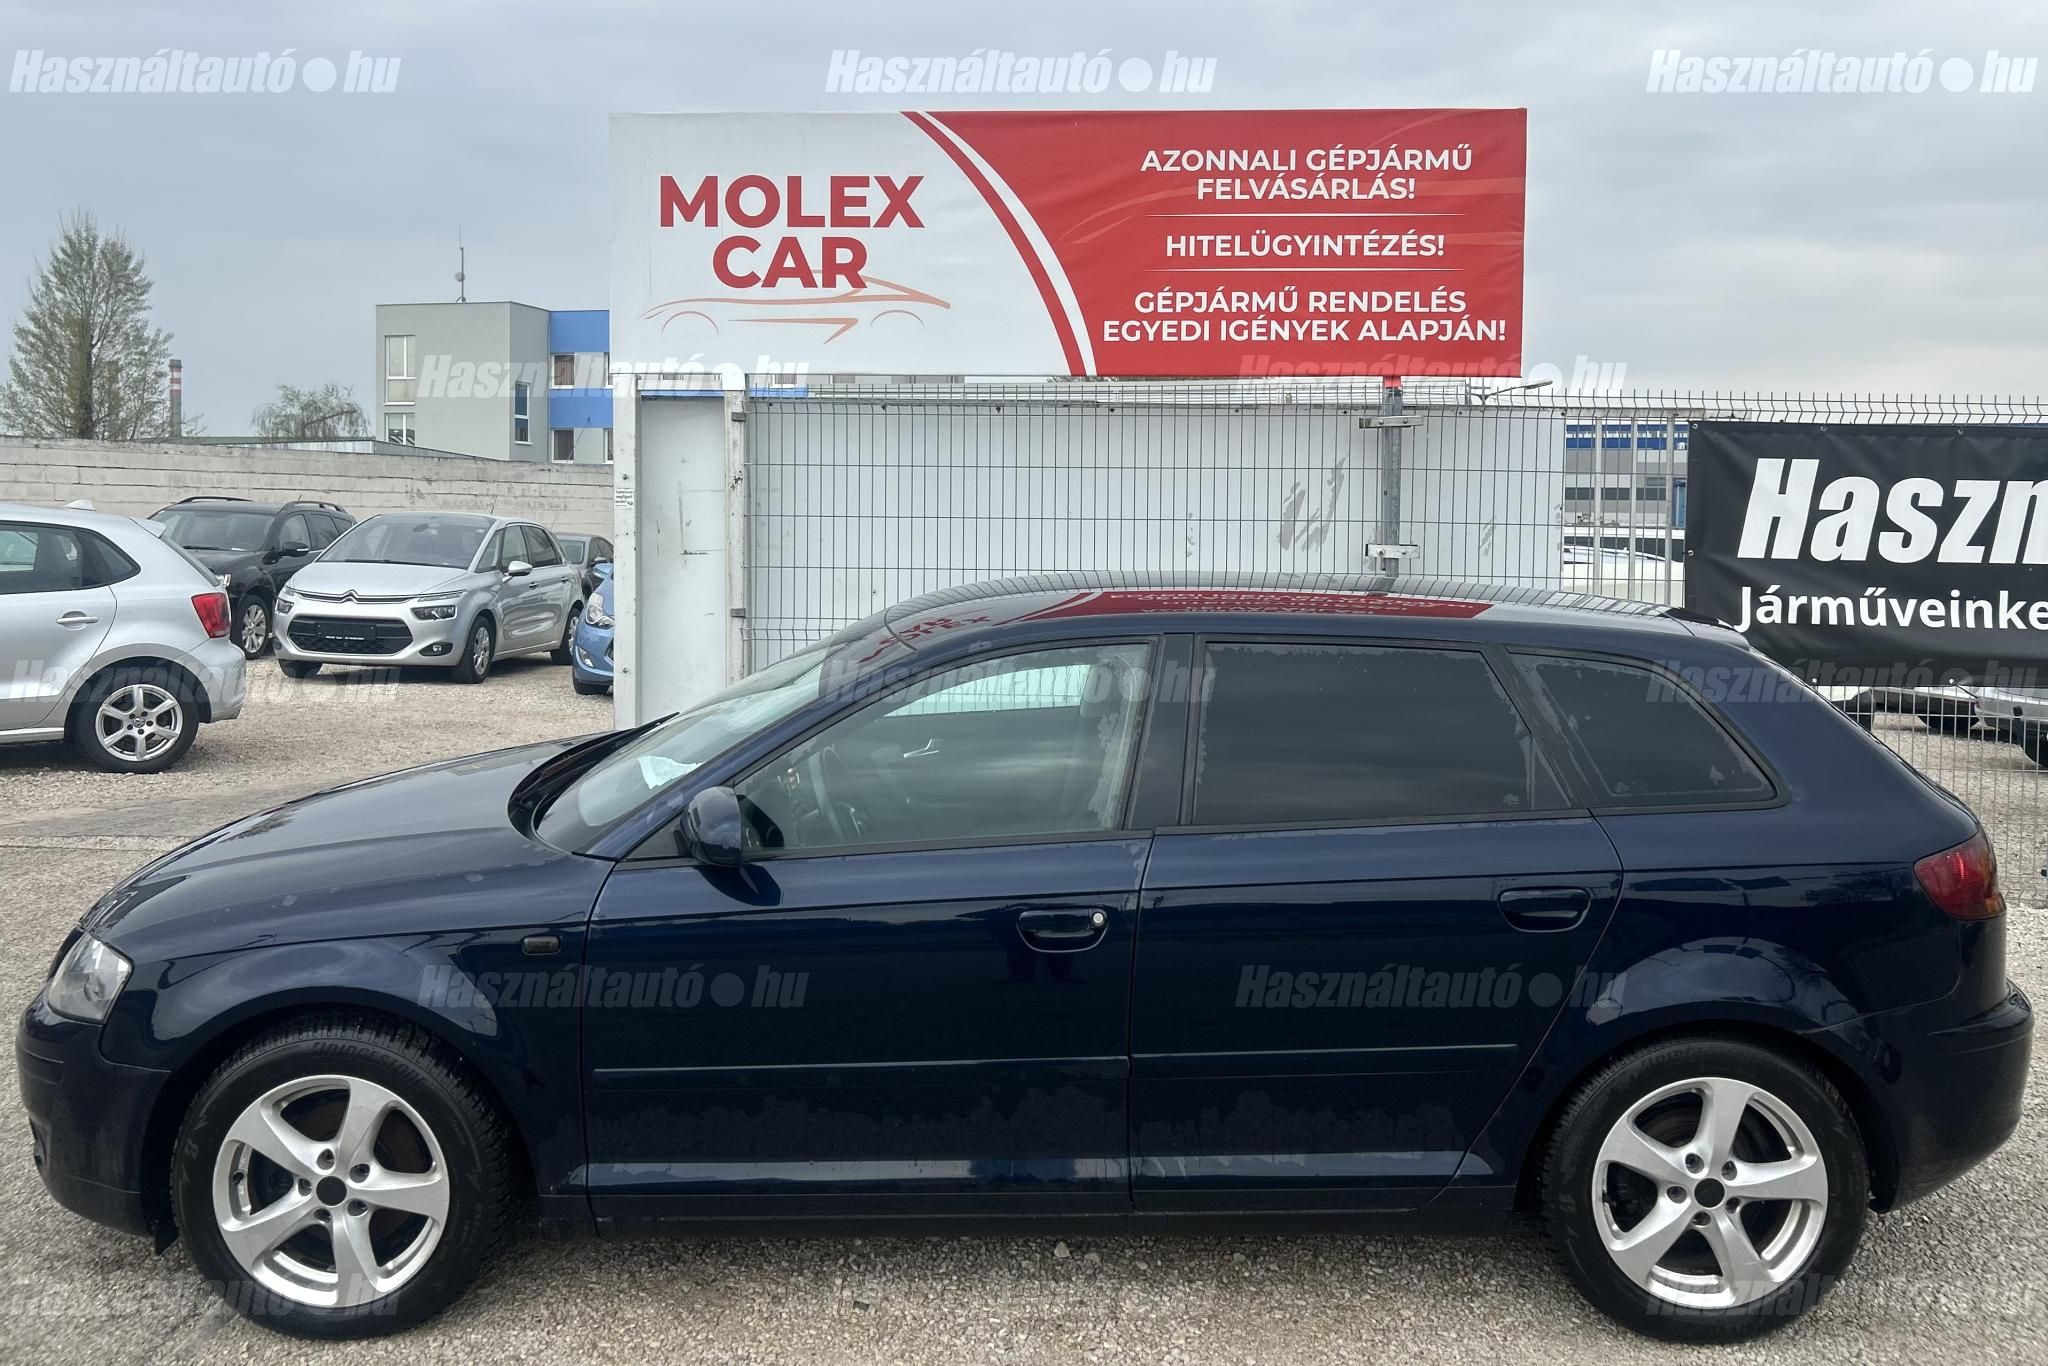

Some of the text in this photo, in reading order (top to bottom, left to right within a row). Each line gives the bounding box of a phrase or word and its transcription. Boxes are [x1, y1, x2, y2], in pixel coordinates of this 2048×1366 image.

[1140, 143, 1472, 171] AZONNALI GÉPJÁRMŰ
[1197, 171, 1415, 200] FELVÁSÁRLÁS!
[660, 175, 925, 228] MOLEX
[1166, 229, 1445, 257] HITELÜGYINTÉZÉS!
[713, 235, 868, 289] CAR
[1134, 284, 1467, 313] GÉPJÁRMŰ RENDELÉS
[1103, 313, 1507, 342] EGYEDI IGÉNYEK ALAPJÁN!
[1737, 458, 2048, 565] Haszn
[1733, 584, 2048, 633] Járműveinke
